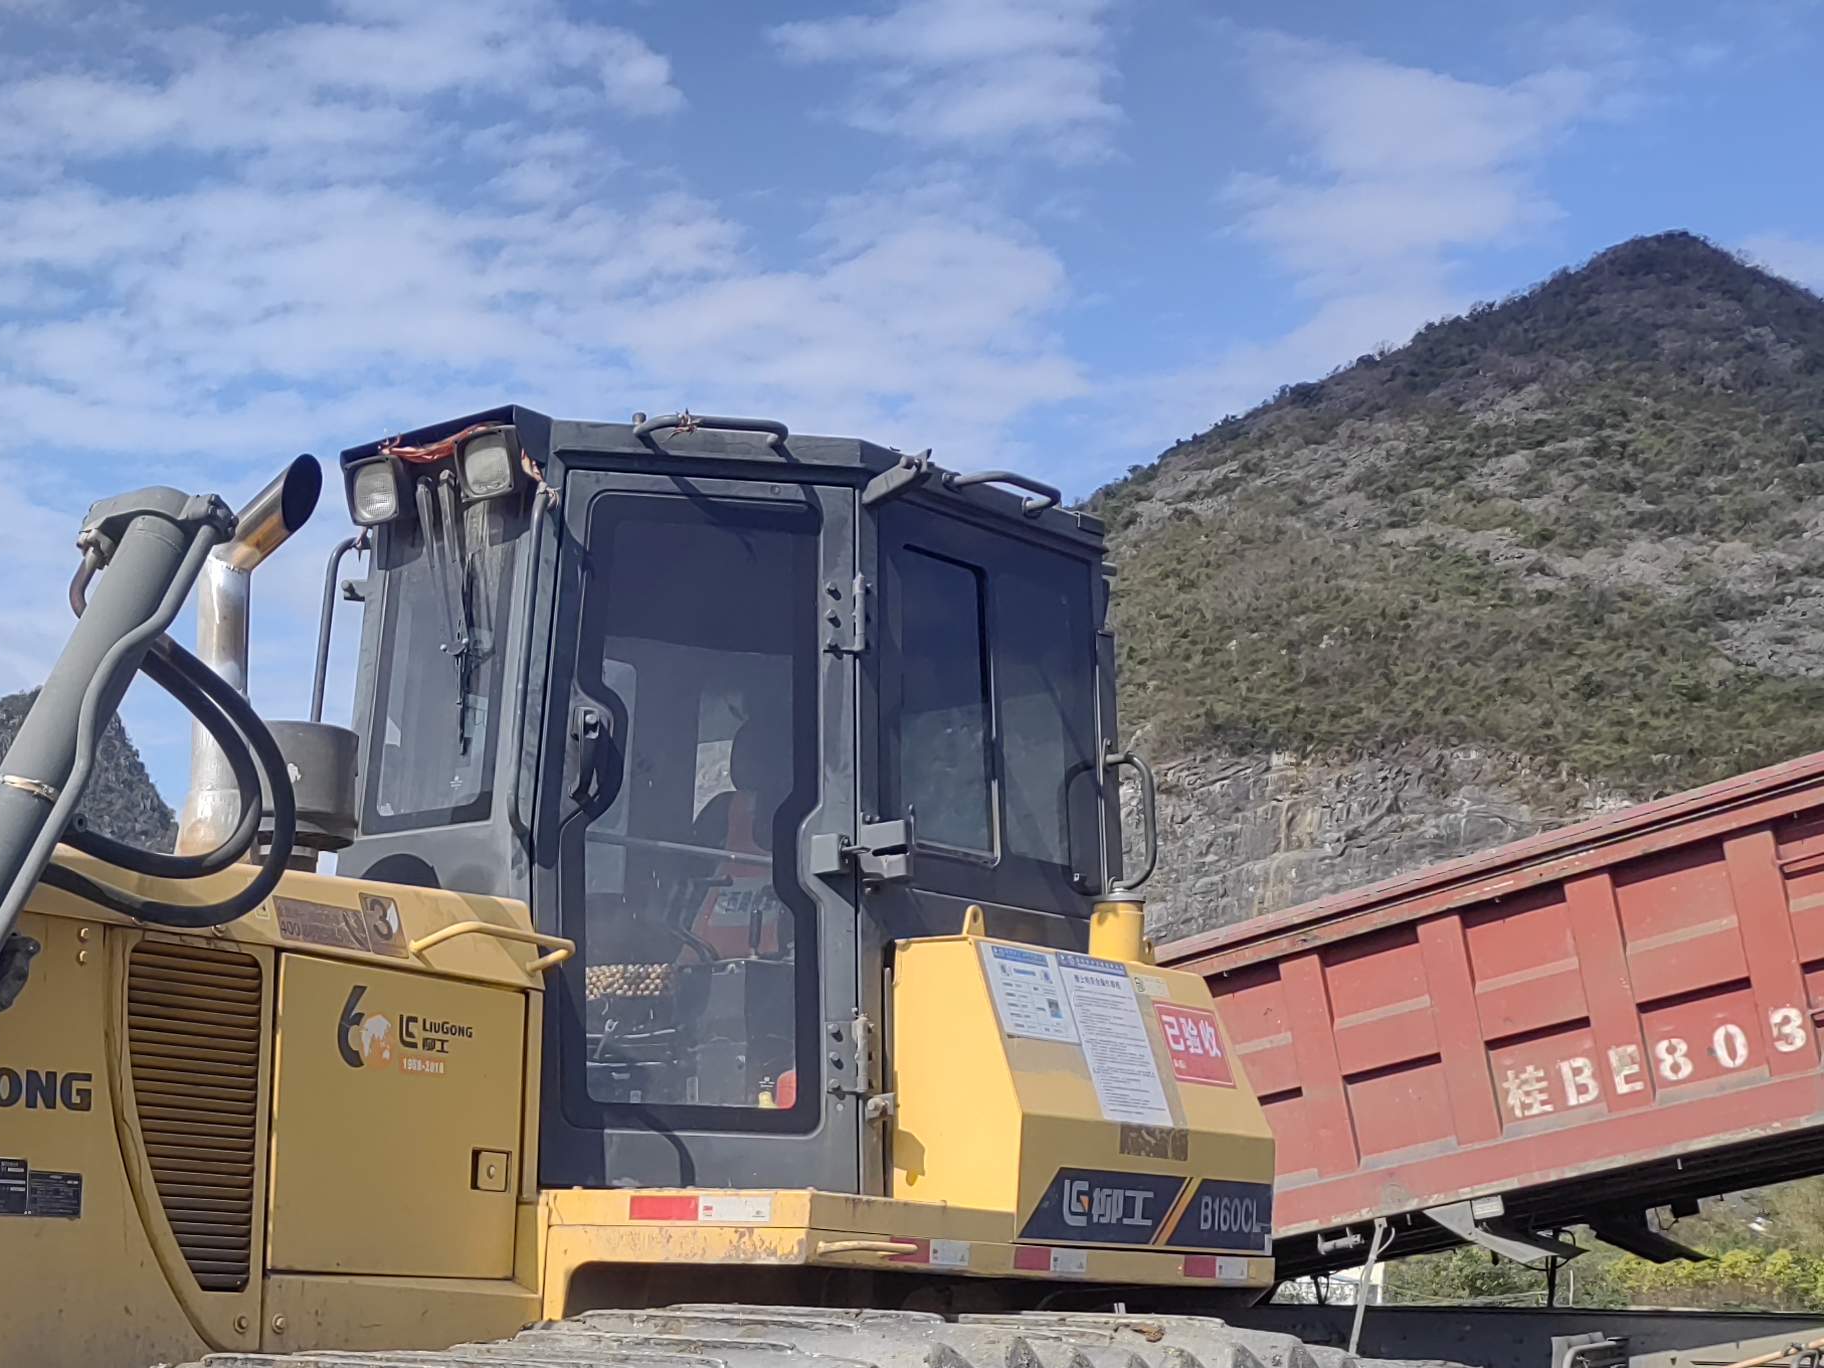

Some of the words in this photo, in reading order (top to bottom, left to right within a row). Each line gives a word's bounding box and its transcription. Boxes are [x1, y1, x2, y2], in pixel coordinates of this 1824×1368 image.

[1161, 1014, 1222, 1058] 已验收
[1091, 1186, 1154, 1226] 柳工
[1200, 1195, 1262, 1233] B160CL
